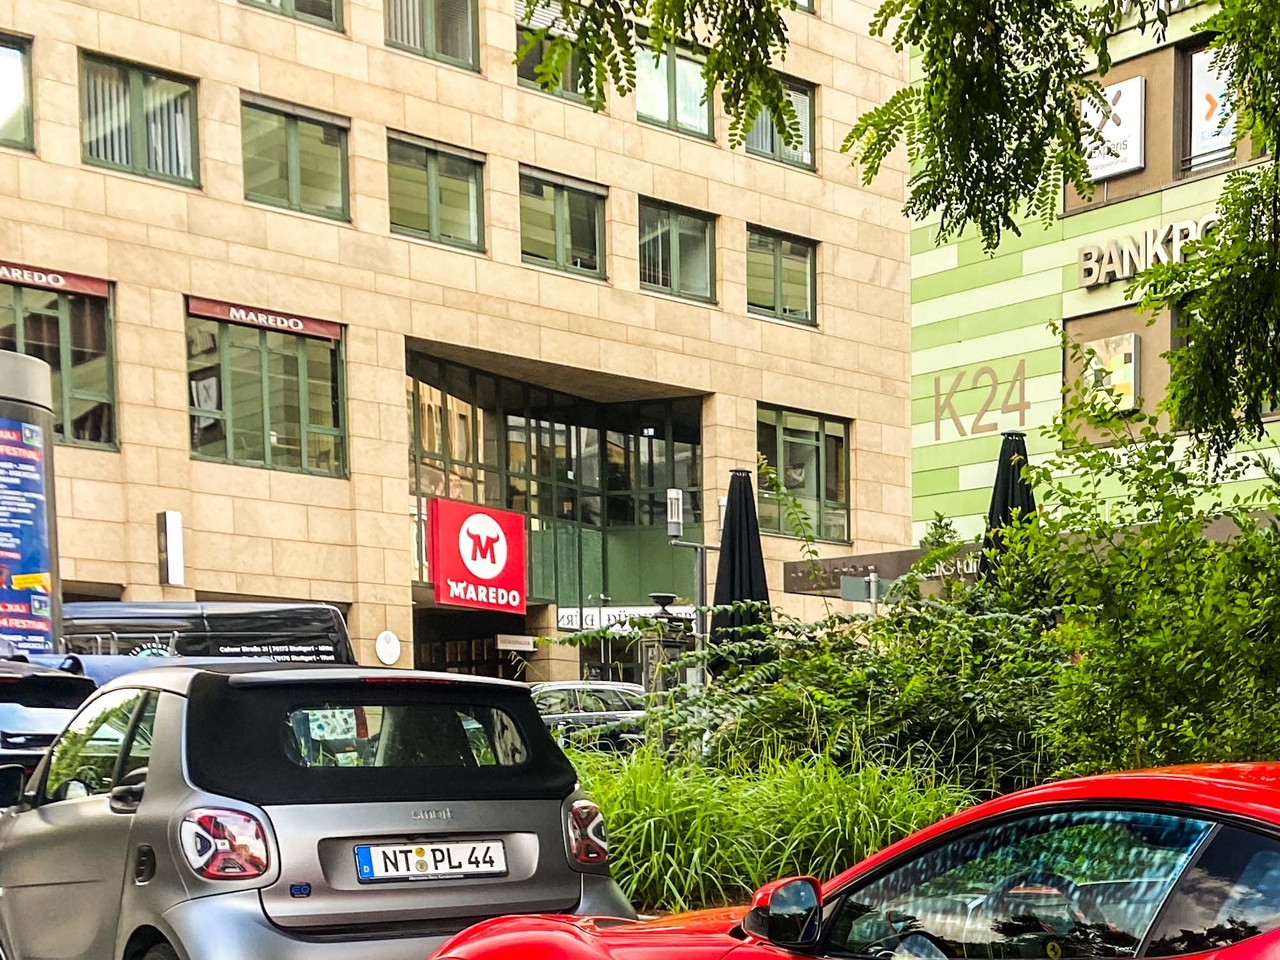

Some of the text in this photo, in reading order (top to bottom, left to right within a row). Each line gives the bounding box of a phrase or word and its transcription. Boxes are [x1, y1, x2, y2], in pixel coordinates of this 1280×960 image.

[228, 306, 304, 331] MAREDO
[933, 358, 1031, 441] K24
[447, 578, 521, 607] MAREDO
[289, 645, 315, 654] Stuttgart
[291, 655, 317, 663] Stuttgart
[363, 846, 495, 873] D NT PL 44
